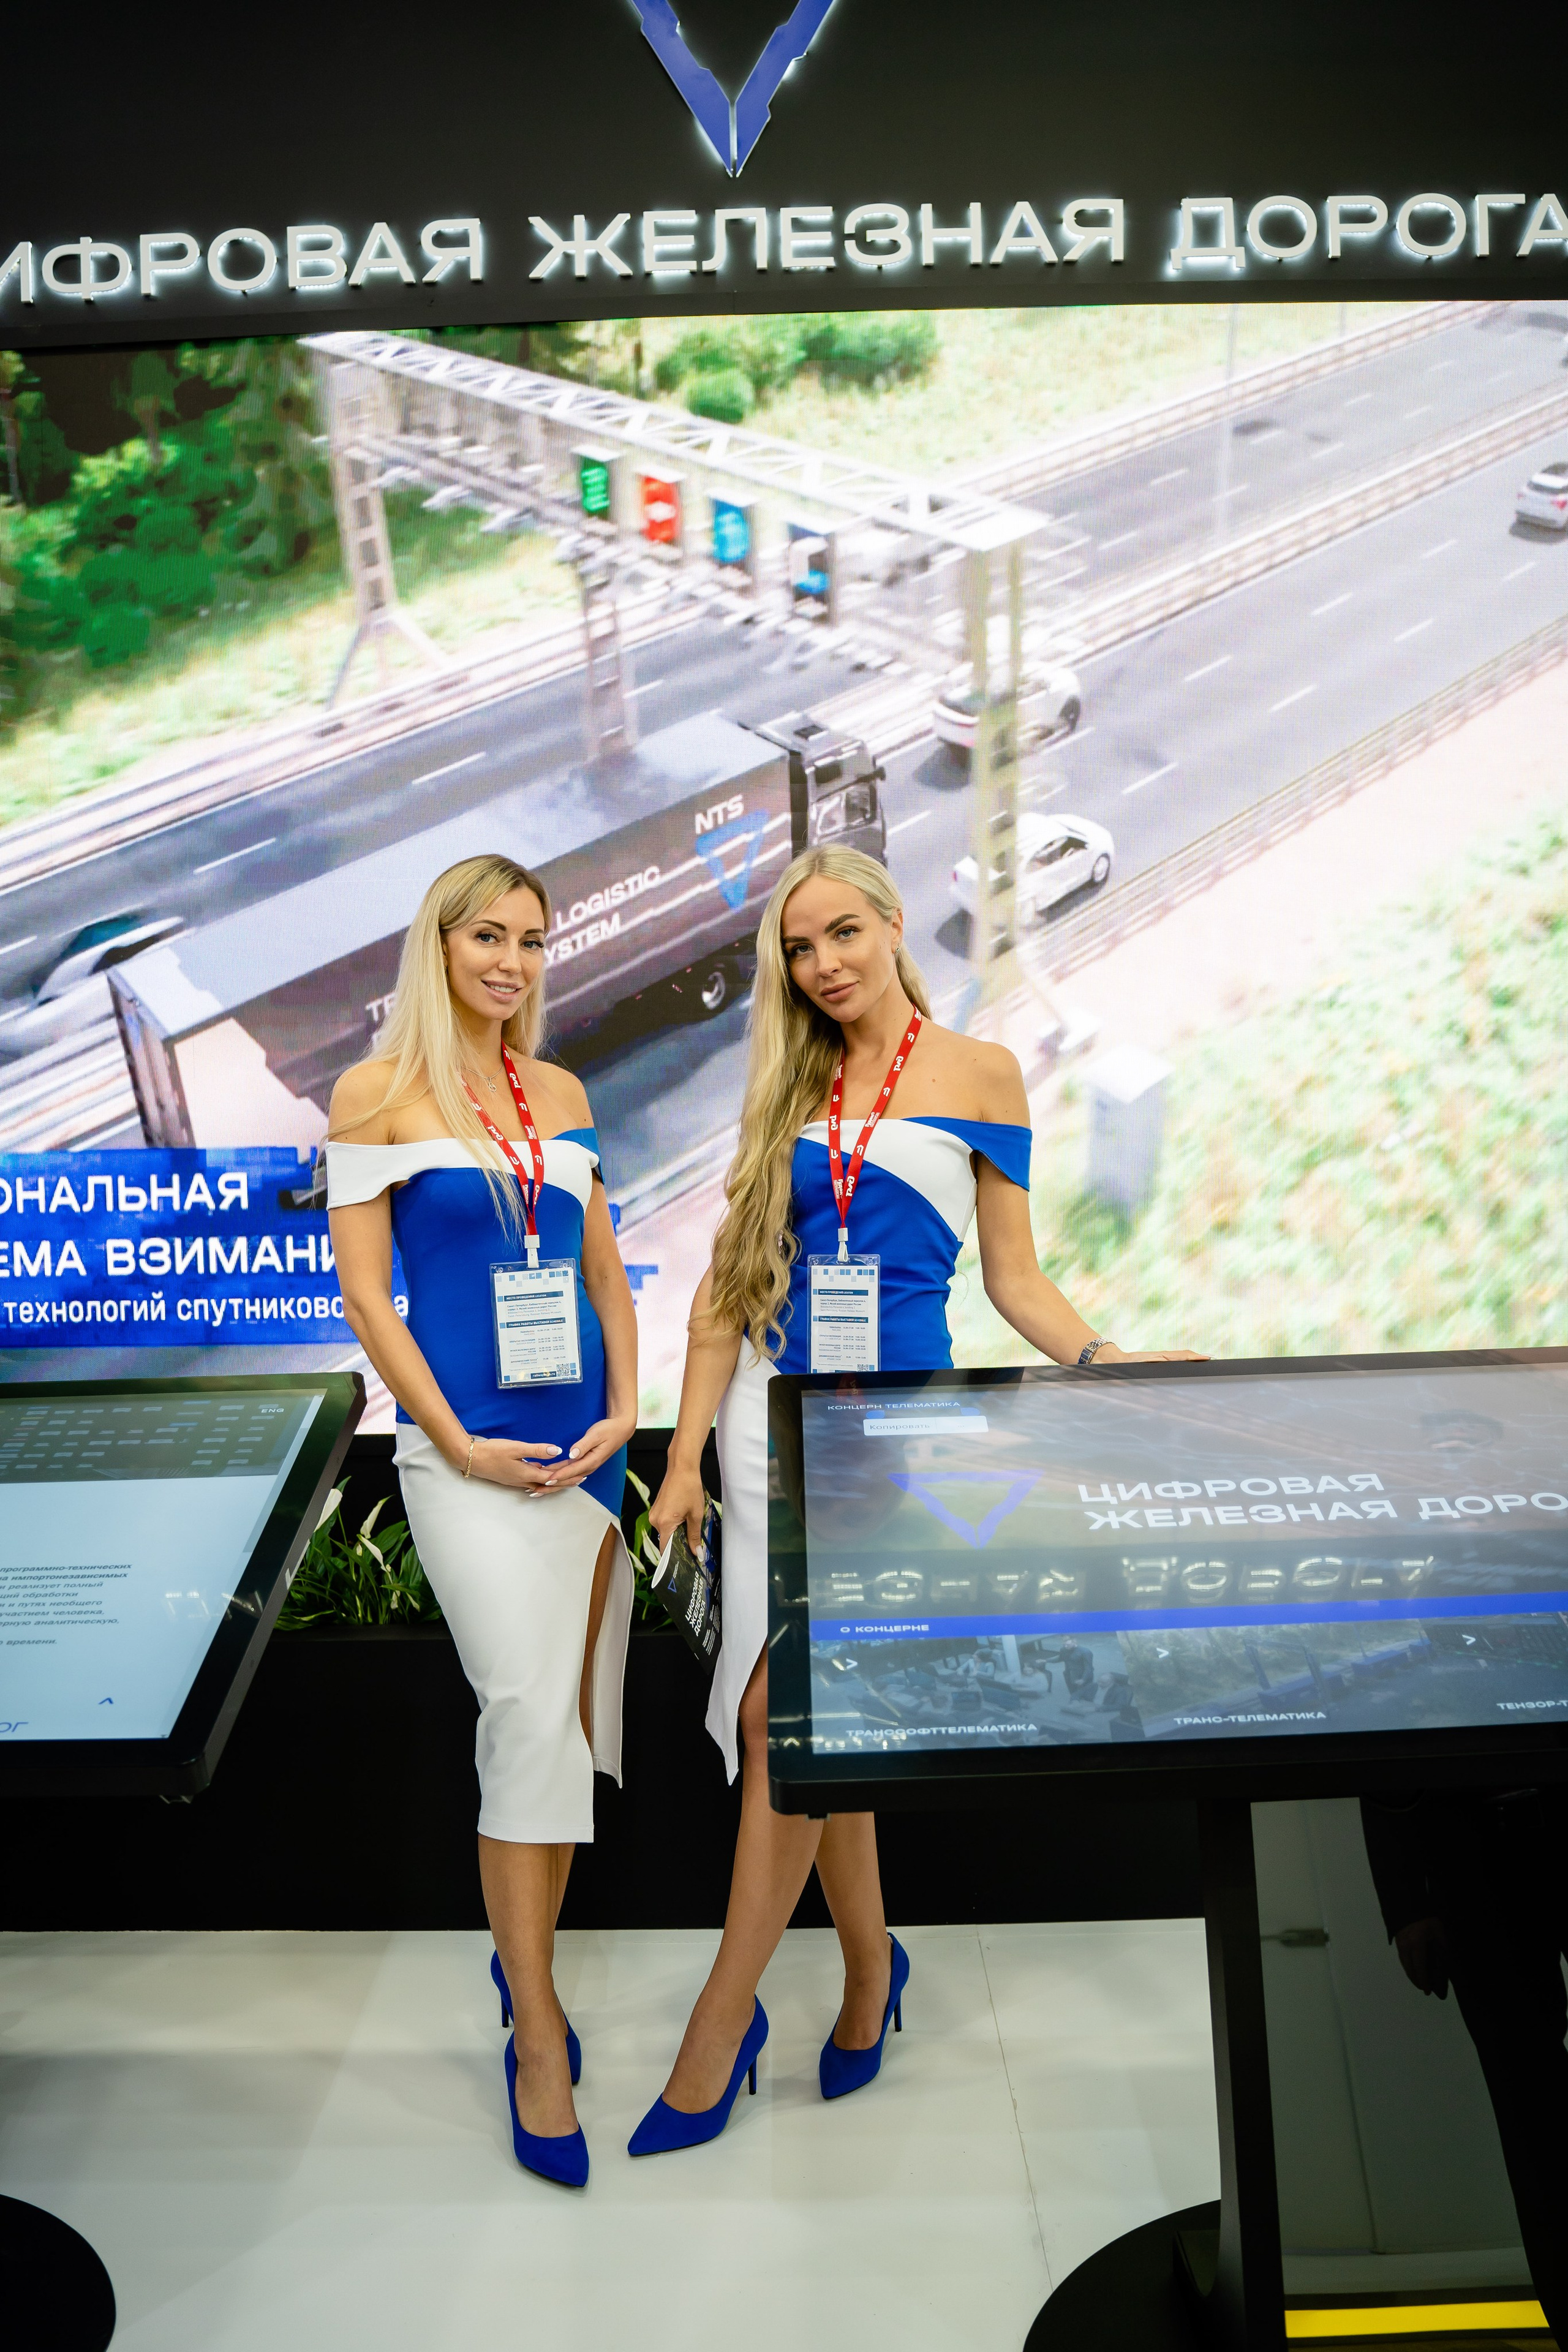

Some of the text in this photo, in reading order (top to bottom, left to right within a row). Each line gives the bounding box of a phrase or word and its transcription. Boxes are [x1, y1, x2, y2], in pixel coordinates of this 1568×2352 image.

[529, 198, 1125, 279] ЖЕЛЕЗНАЯ
[1169, 193, 1568, 270] ДОРОГА
[695, 794, 744, 834] NTS
[556, 865, 660, 930] LOGISTIC
[3, 1290, 166, 1323] технологий
[1078, 1474, 1384, 1504] ЦИФРОВАЯ
[1084, 1492, 1568, 1530] ЖЕЛЕЗНАЯ ДОРО
[0, 1564, 132, 1574] программно-технических
[11, 1572, 129, 1581] импортонезависимых
[685, 1570, 699, 1621] ЦИФРОВАЯ
[689, 1578, 704, 1629] ЖЕЛЕЗНАЯ
[693, 1600, 706, 1637] ДОРОГА
[855, 1624, 930, 1633] КОНЦЕРНЕ
[846, 1723, 1038, 1737] ТРАНССОФТТЕЛЕМАТИКА
[1174, 1711, 1327, 1725] ТРАНС-ТЕЛЕМАТИКА
